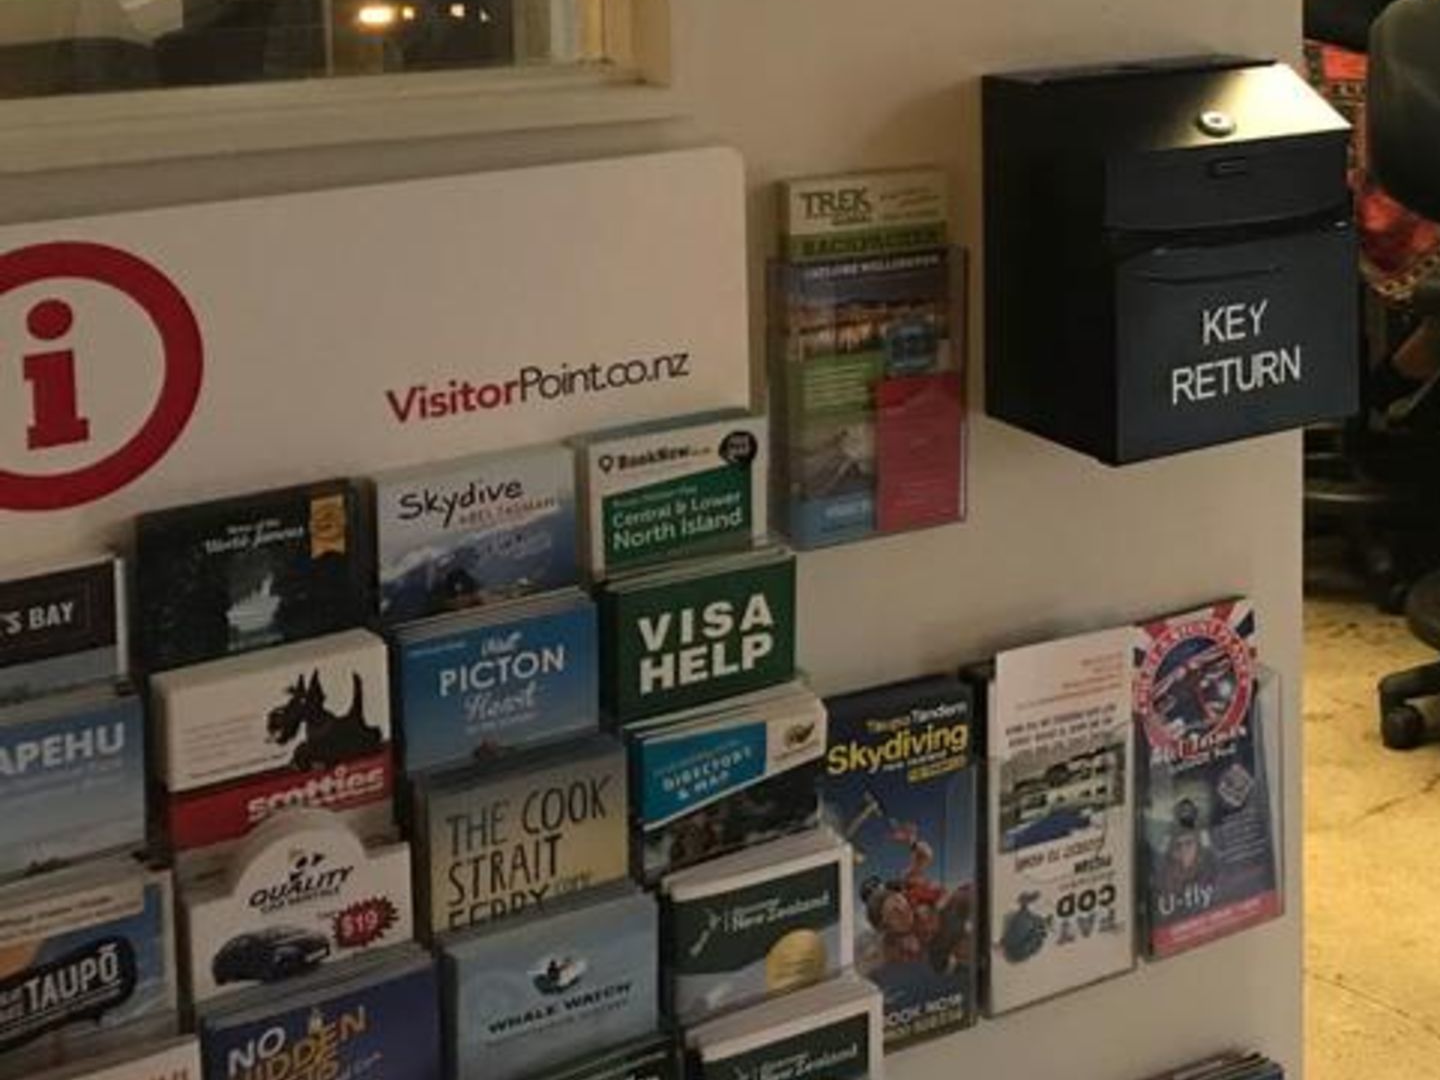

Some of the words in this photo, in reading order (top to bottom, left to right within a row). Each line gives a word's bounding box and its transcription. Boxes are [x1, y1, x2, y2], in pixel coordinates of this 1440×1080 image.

[800, 186, 871, 220] TREK
[1202, 300, 1268, 345] KEY
[385, 353, 690, 423] VisitorPoint.co.nz
[1171, 347, 1301, 405] RETURN
[397, 480, 523, 529] Skydive
[612, 502, 672, 529] Central
[691, 491, 741, 511] Lower
[612, 522, 676, 551] North
[681, 507, 743, 535] Island
[29, 602, 74, 630] BAY
[638, 592, 774, 652] VISA
[439, 643, 566, 697] PICTON
[638, 633, 774, 696] HELP
[827, 723, 969, 776] Skydiving
[446, 800, 509, 857] THE
[520, 774, 613, 835] COOK
[249, 866, 355, 909] QUALITY
[447, 833, 563, 907] STRAIT
[1056, 883, 1116, 918] COD
[1157, 881, 1214, 916] U-fly
[487, 1005, 555, 1034] WHALE
[562, 981, 632, 1011] WATCH
[228, 1026, 287, 1080] NO
